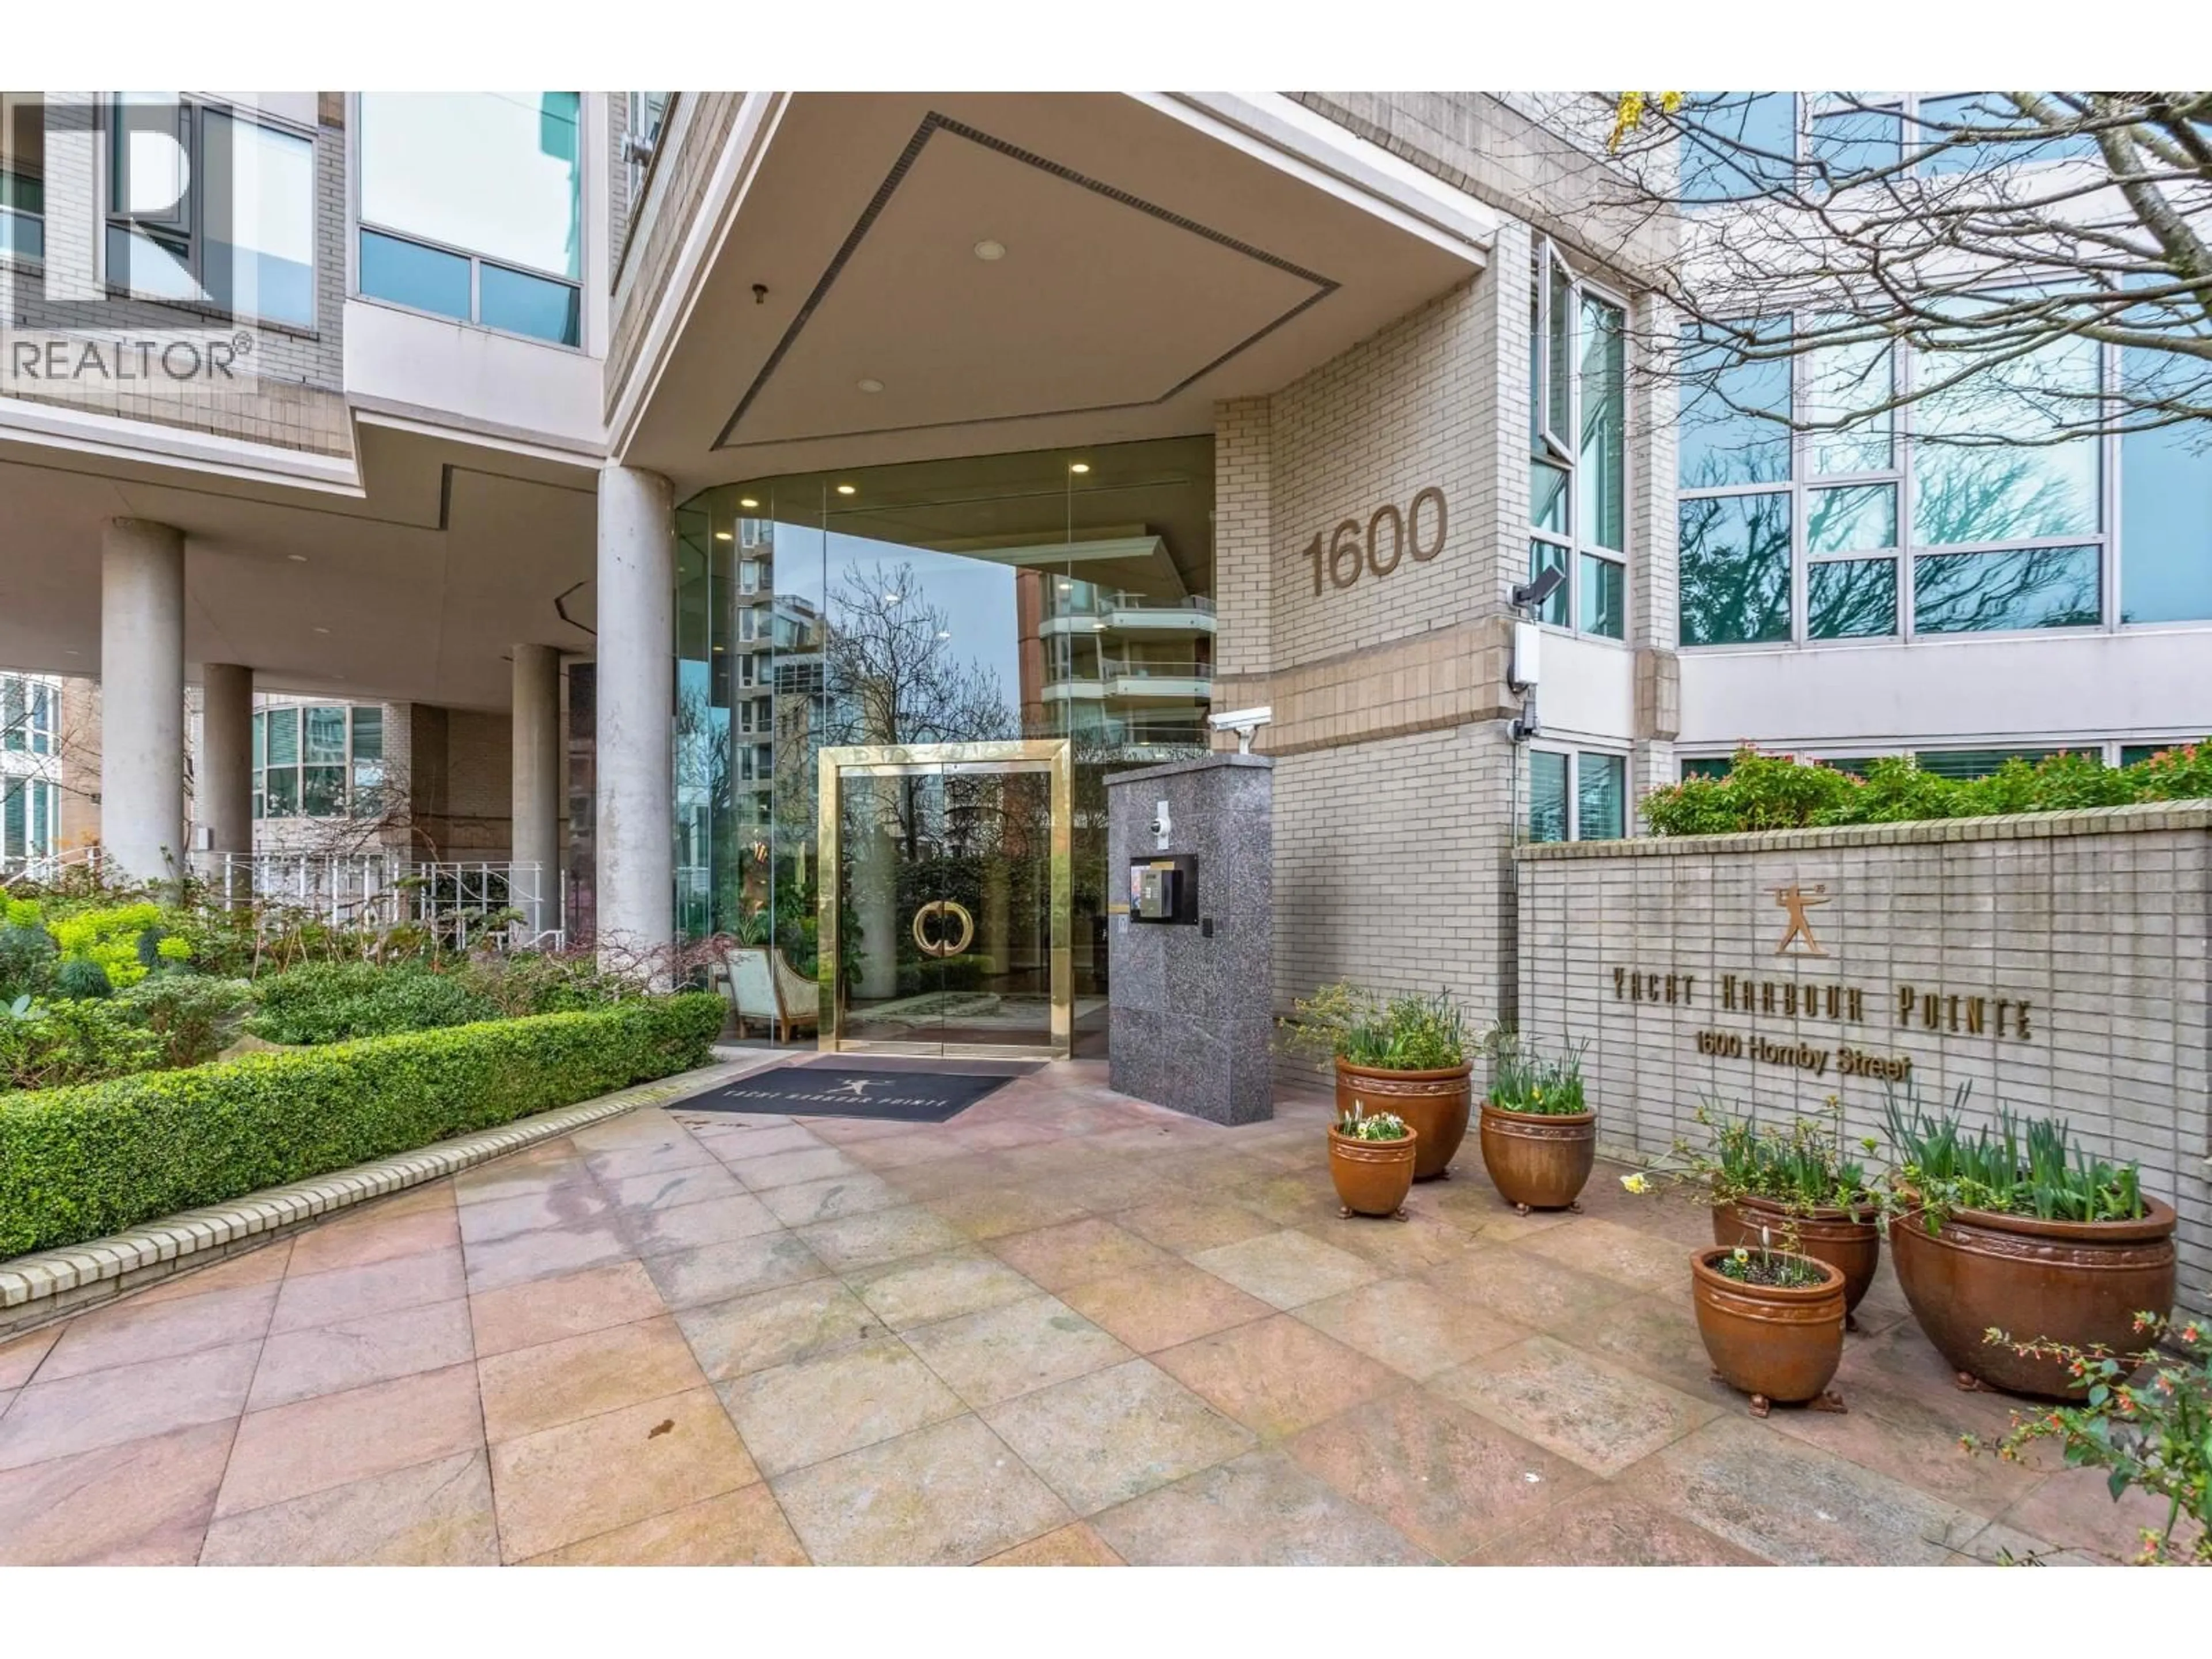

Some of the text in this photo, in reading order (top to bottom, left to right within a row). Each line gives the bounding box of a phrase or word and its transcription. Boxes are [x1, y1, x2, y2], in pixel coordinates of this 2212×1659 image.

[1302, 486, 1448, 596] 1600
[1613, 967, 2032, 1039] YACHT HARBOUR POINTE
[1696, 1031, 1912, 1082] 1600 Hornby Street
